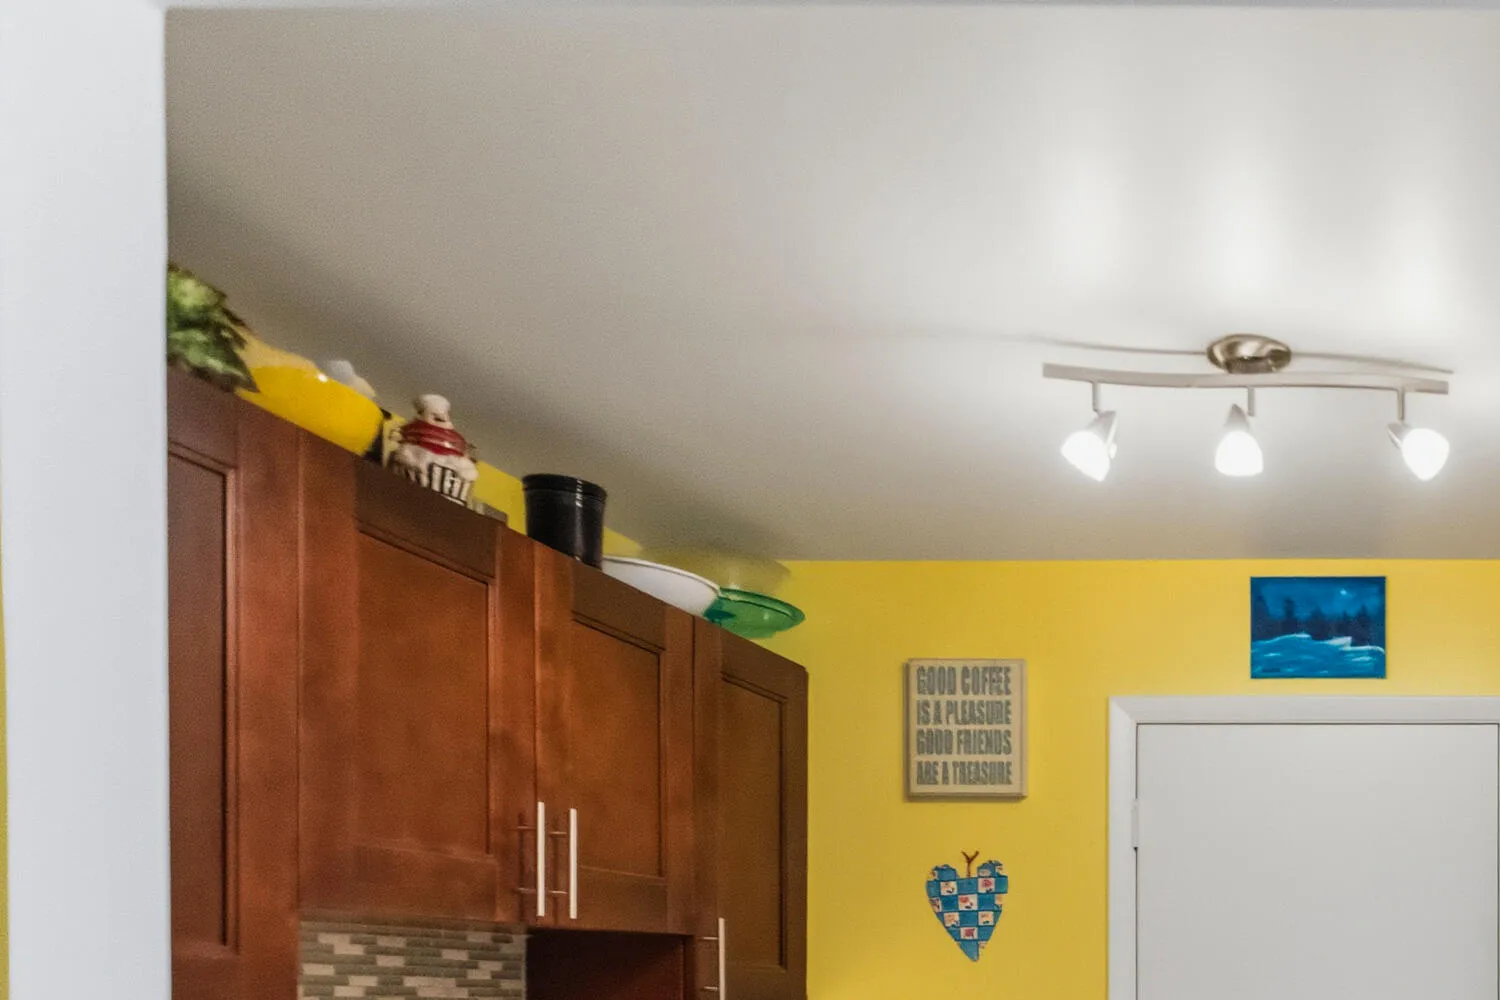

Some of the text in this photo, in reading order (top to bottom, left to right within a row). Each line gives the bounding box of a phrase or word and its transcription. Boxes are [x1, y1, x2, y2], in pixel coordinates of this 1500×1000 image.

[916, 666, 1012, 695] GOOD COFFEE
[916, 700, 1012, 725] IS A PLEASURE
[916, 729, 1012, 755] GOOD FRIENDS
[916, 760, 1012, 785] ARE A TREASURE
